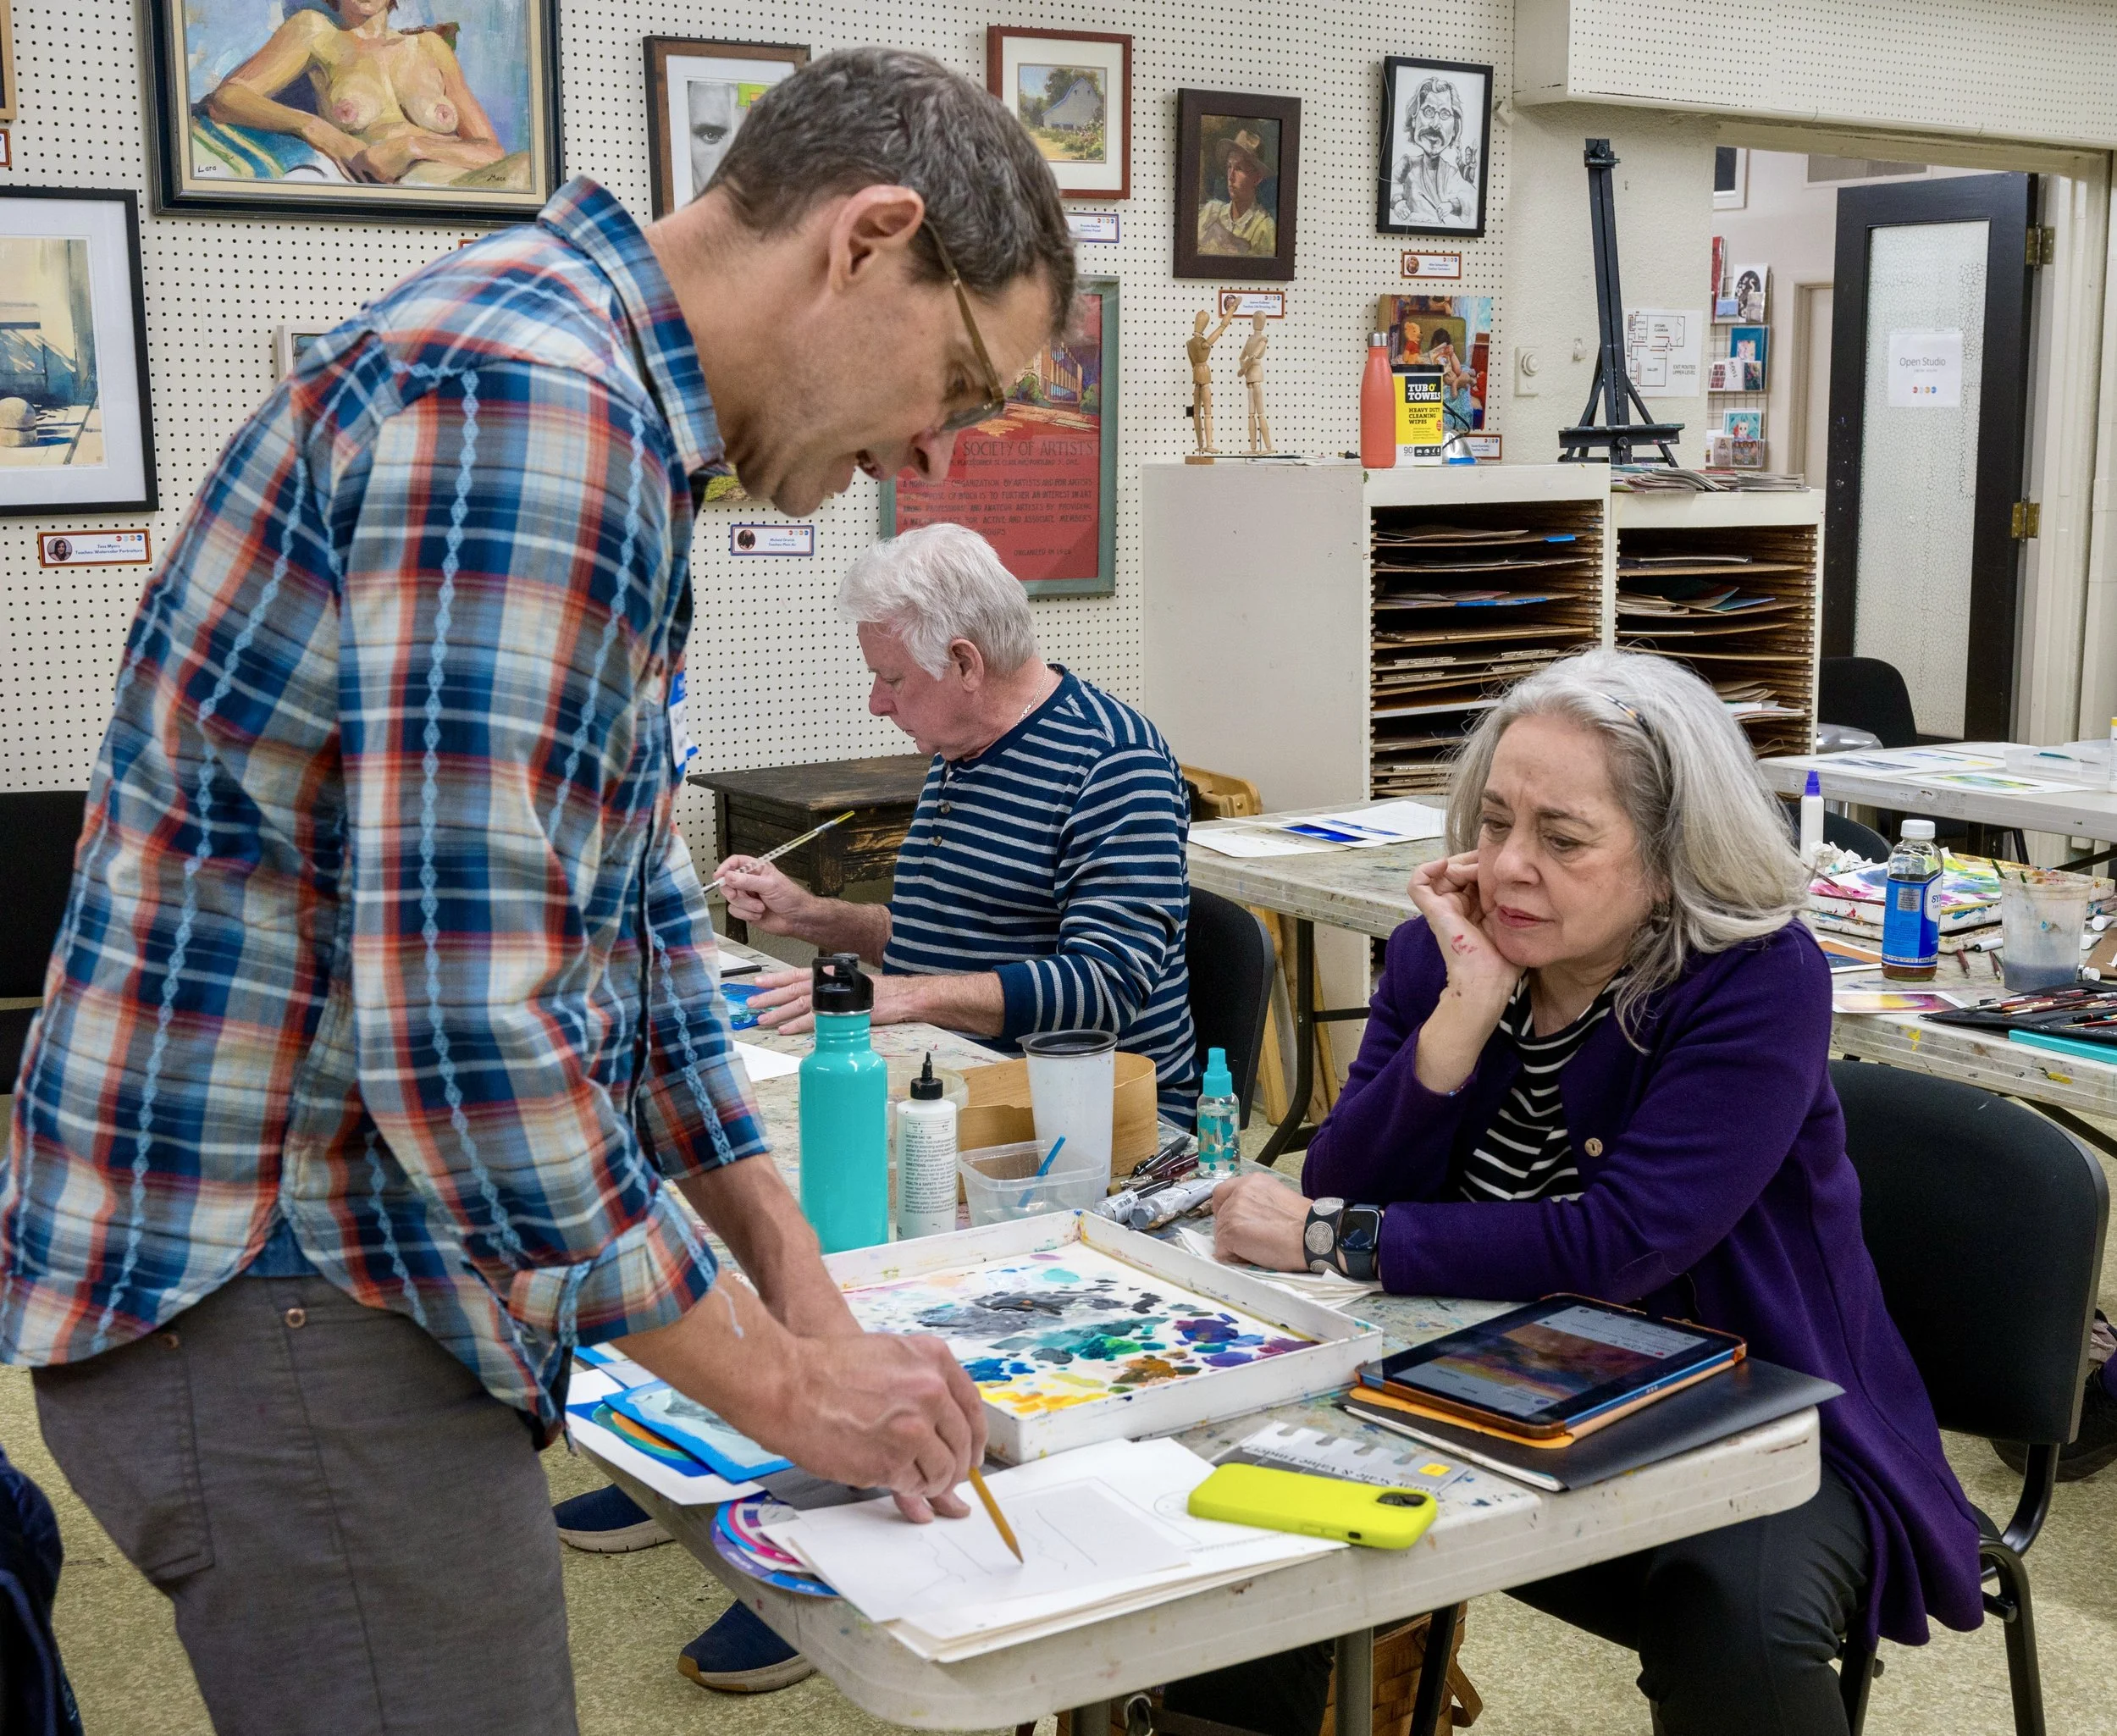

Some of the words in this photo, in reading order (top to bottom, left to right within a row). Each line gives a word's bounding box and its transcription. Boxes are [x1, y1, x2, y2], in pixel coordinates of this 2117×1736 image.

[1899, 357, 1921, 368] Open
[1922, 357, 1946, 366] Studio
[1407, 384, 1429, 392] TUB
[1407, 392, 1441, 401] TOWELS
[964, 441, 1014, 457] SOCIETY
[1019, 440, 1034, 456] OF
[1041, 440, 1093, 456] ARTISTS
[990, 491, 998, 500] TO
[1252, 1446, 1296, 1462] Finder
[1298, 1458, 1337, 1473] Value
[1357, 1472, 1391, 1486] Scale
